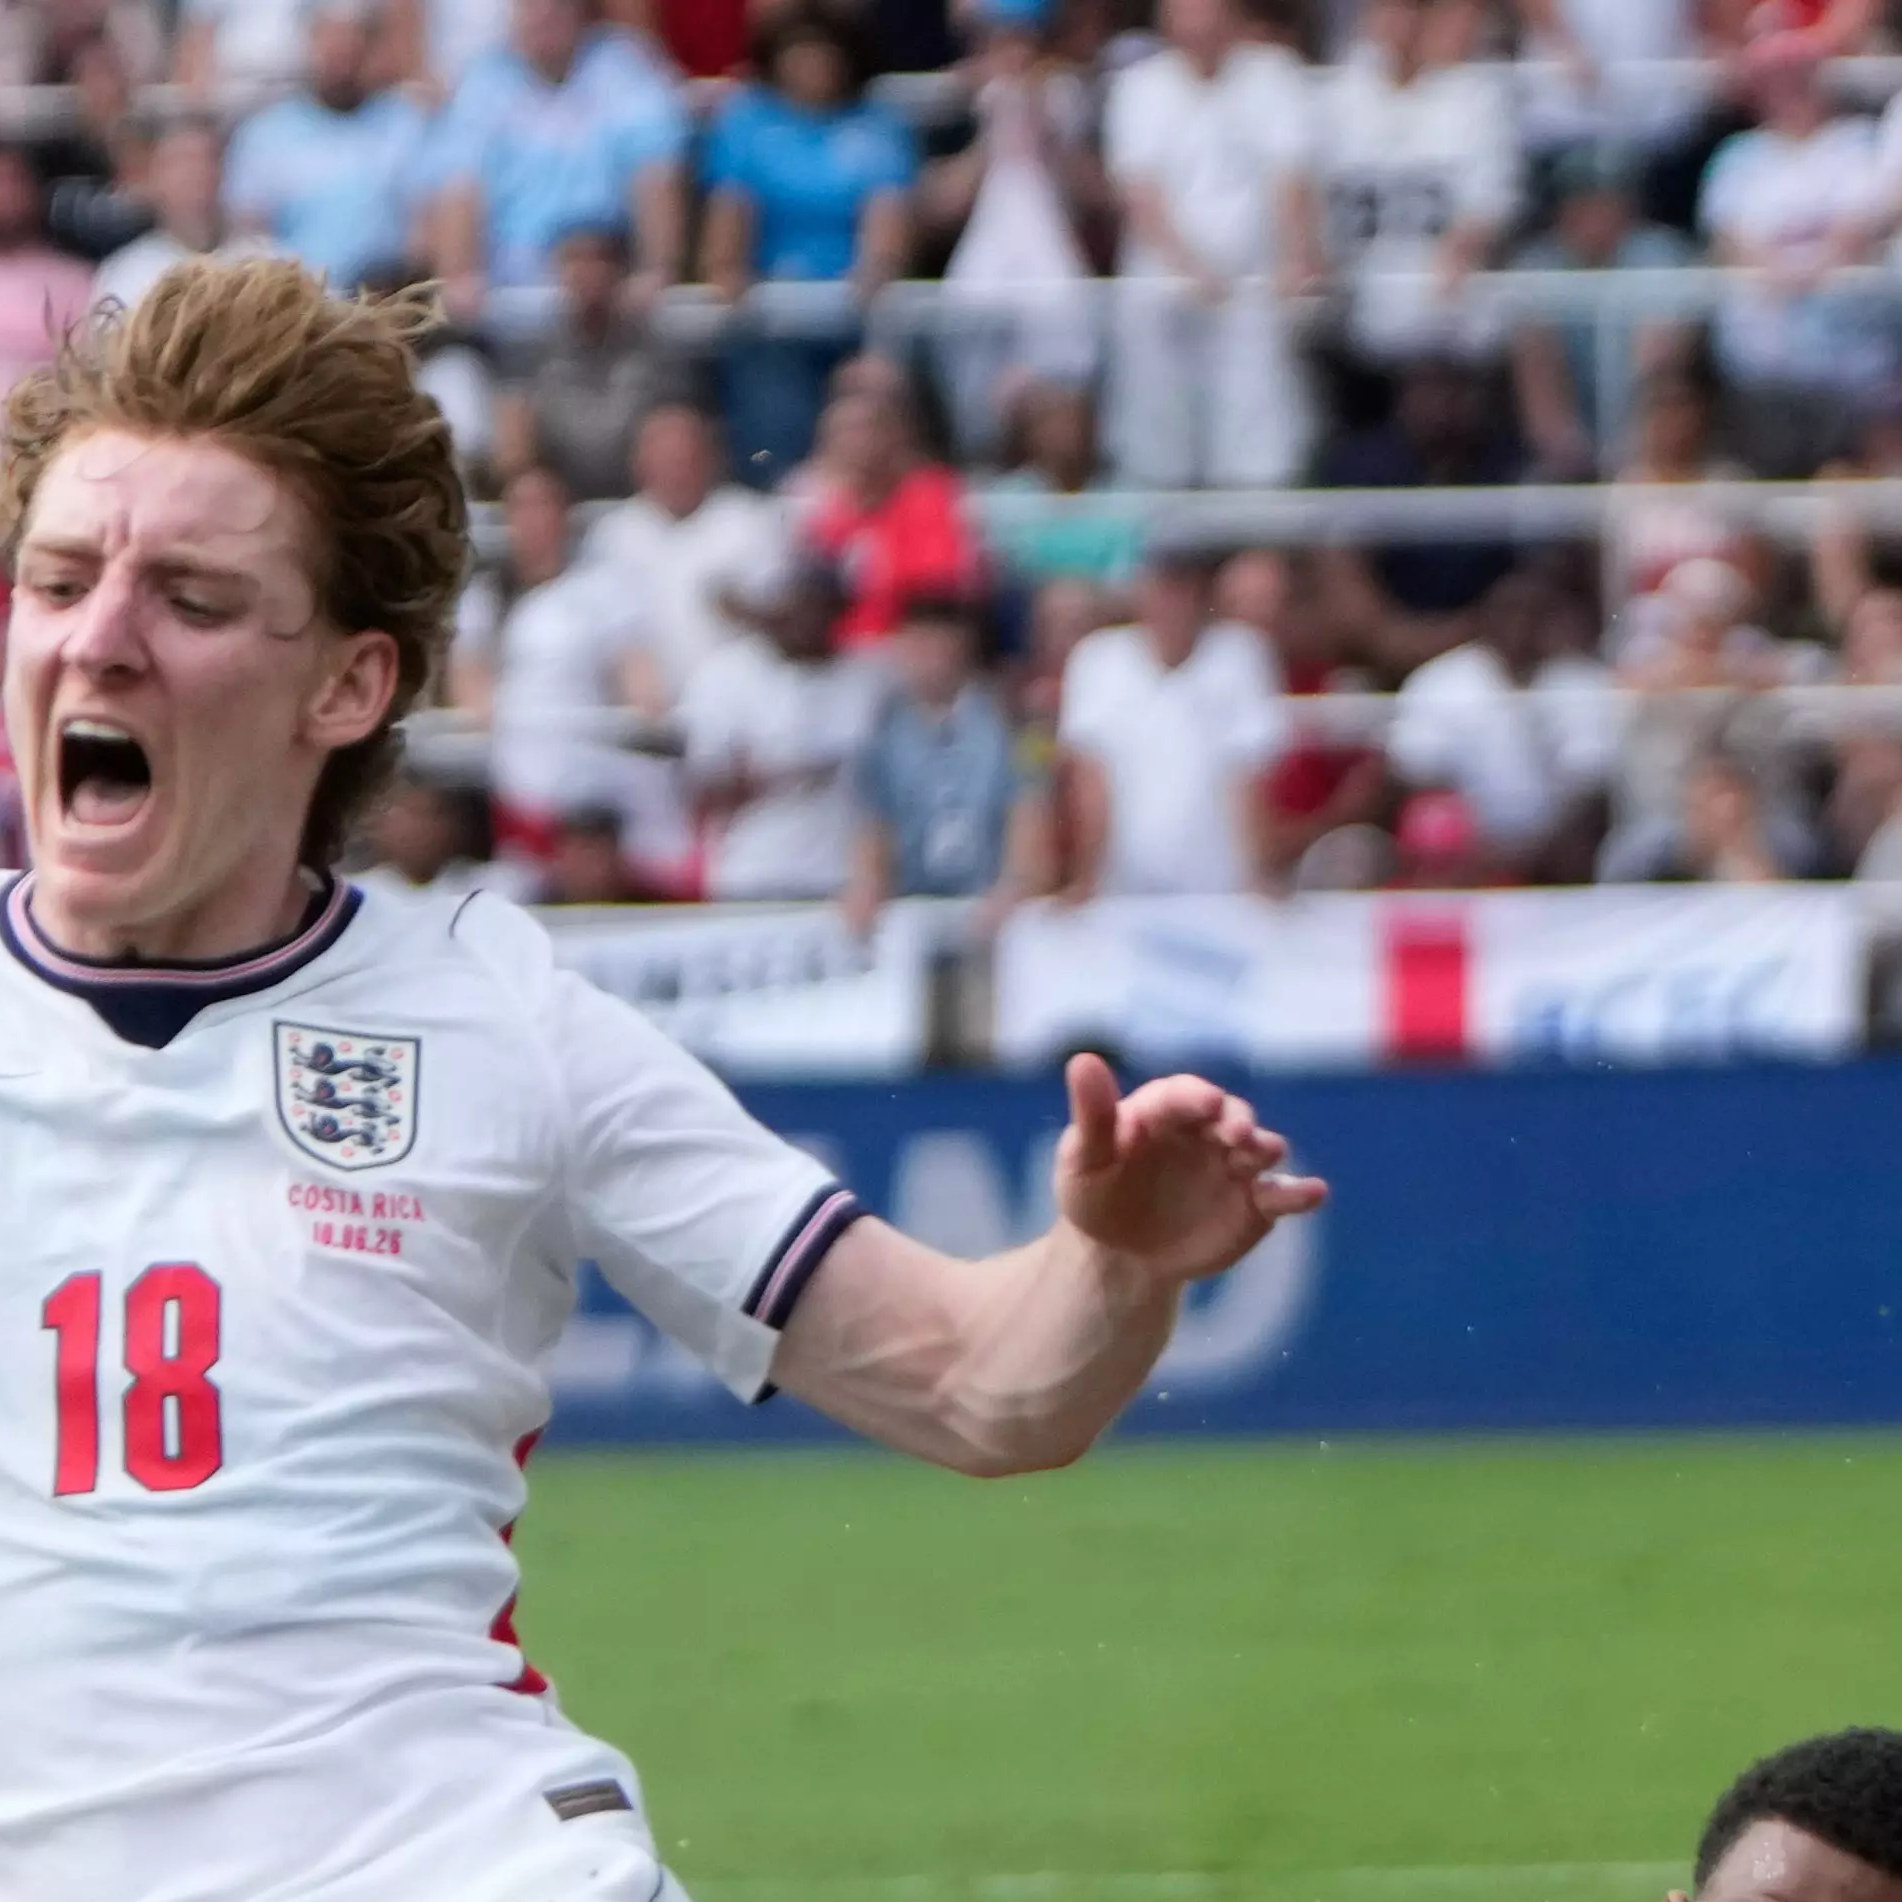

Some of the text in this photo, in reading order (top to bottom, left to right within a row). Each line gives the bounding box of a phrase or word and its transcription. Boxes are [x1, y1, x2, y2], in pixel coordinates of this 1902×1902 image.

[287, 1183, 426, 1222] COSTA RICA
[41, 1261, 223, 1498] 18
